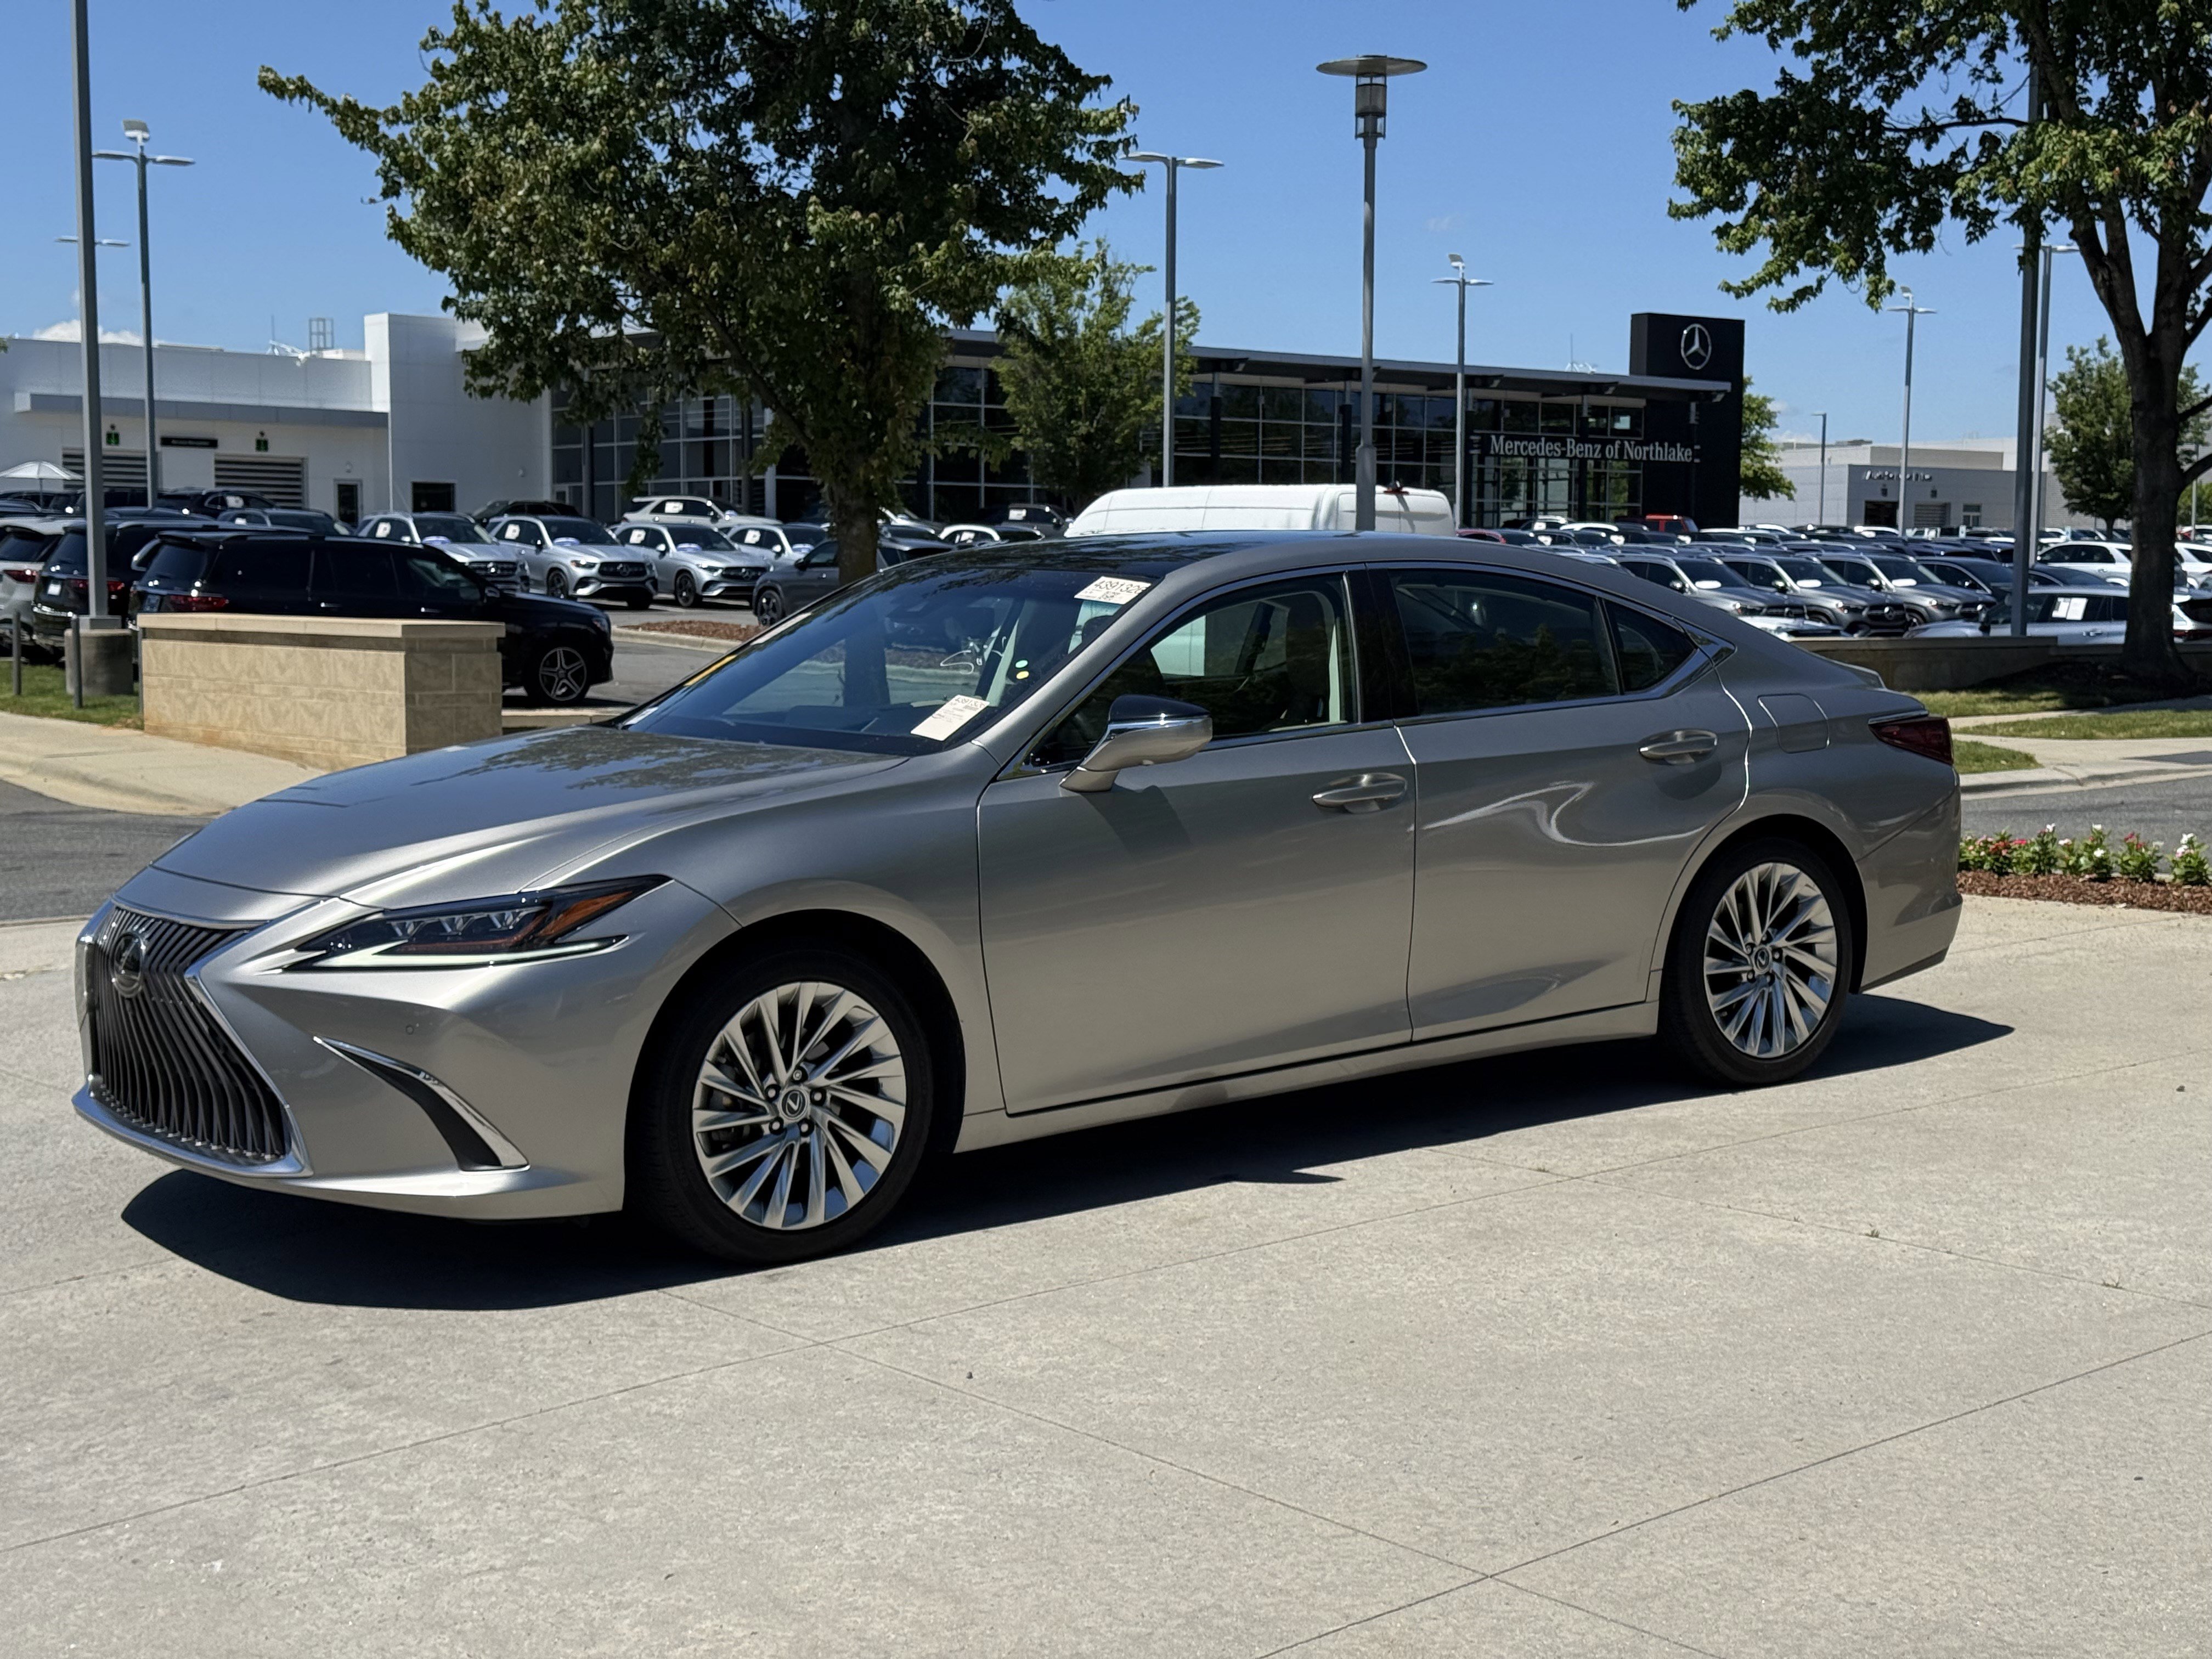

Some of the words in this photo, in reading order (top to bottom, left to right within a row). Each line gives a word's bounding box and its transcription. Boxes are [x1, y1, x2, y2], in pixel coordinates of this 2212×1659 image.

[1489, 435, 1602, 459] Mercedes-Benz
[1605, 440, 1621, 459] of
[1623, 441, 1692, 462] Northlake
